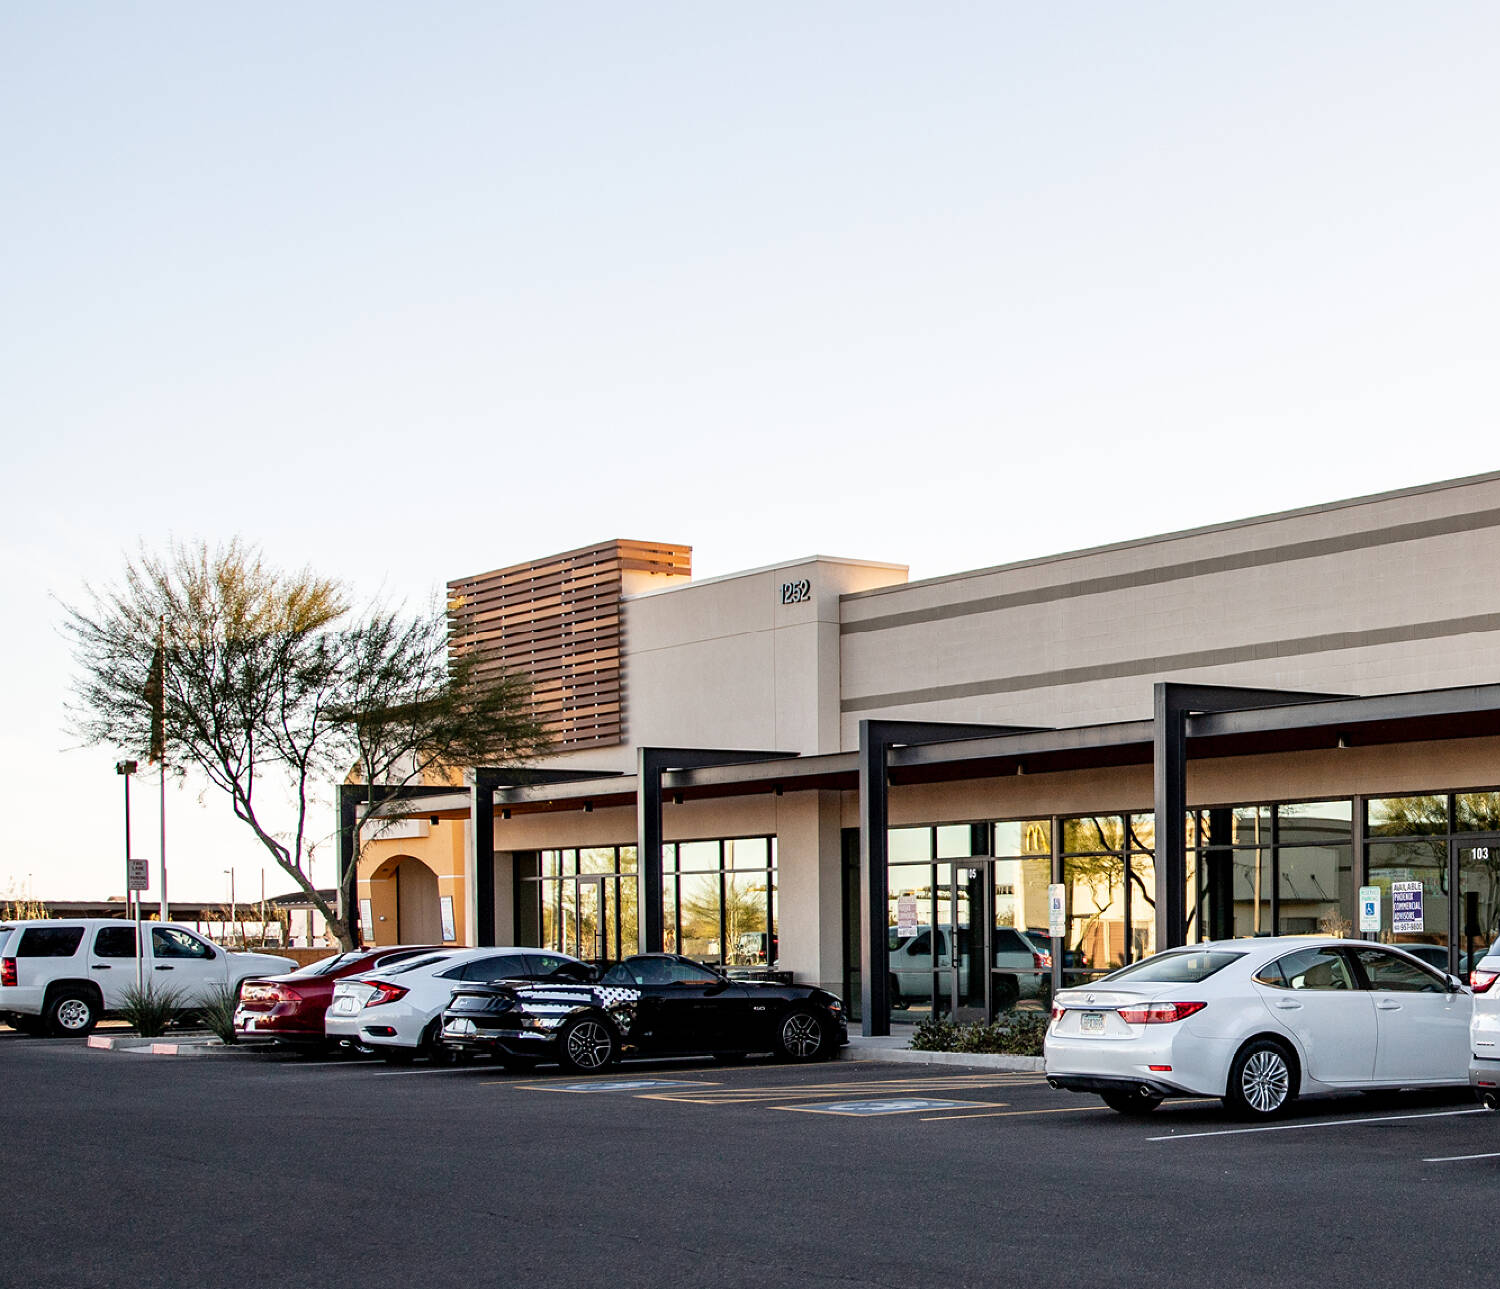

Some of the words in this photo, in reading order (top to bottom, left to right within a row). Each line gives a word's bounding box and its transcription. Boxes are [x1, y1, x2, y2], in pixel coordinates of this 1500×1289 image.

[780, 579, 811, 604] 1252
[1472, 847, 1489, 860] 103
[1394, 882, 1421, 892] AVAILABLE
